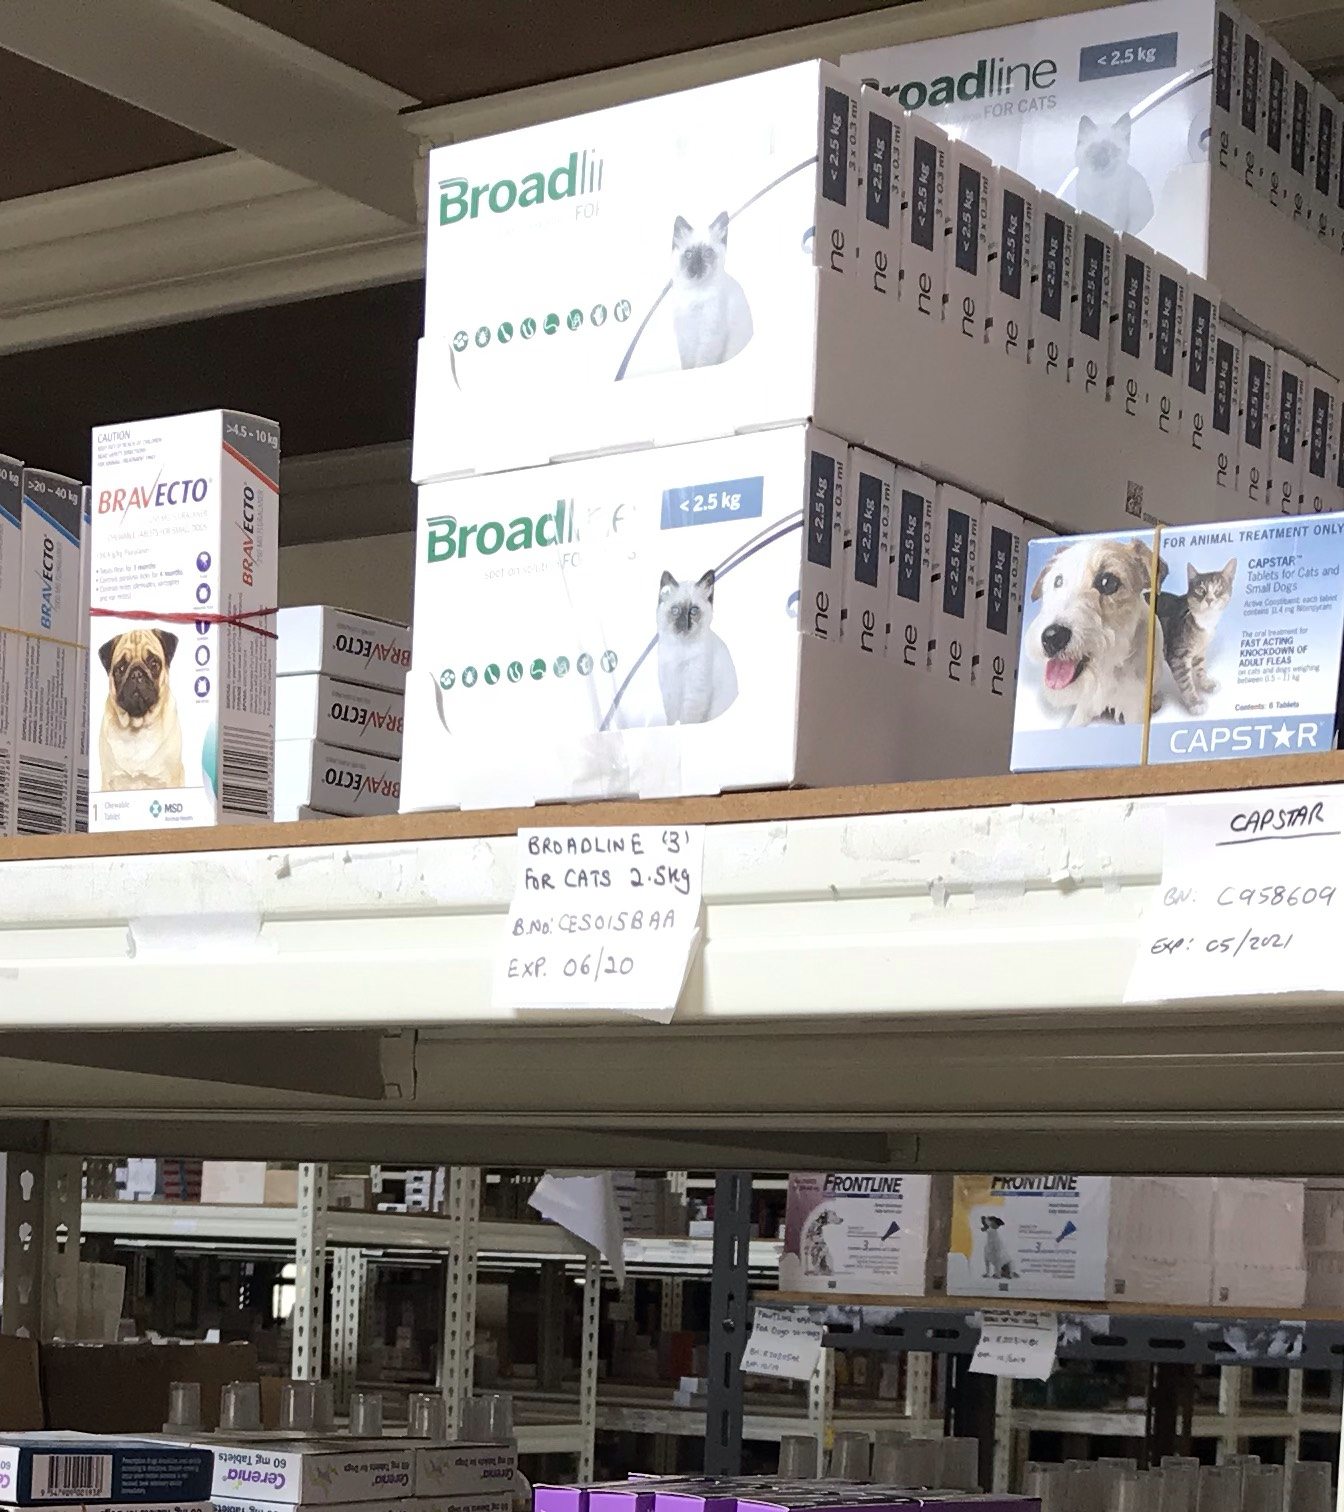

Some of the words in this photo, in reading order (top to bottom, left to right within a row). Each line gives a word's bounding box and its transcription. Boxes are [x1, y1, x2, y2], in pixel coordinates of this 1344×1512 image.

[1111, 47, 1132, 65] 2.5
[1135, 46, 1156, 64] kg
[984, 102, 1014, 118] FOR
[1018, 94, 1057, 114] CATS
[98, 476, 208, 516] BRAVECTO
[693, 494, 717, 513] 2.5
[722, 491, 741, 512] kg
[243, 485, 255, 587] BRAVECTO
[1164, 535, 1186, 548] FOR
[1190, 531, 1235, 547] ANIMAL
[1239, 525, 1309, 543] TREATMENT
[1313, 522, 1344, 536] ONLY
[1247, 570, 1279, 582] Tablets
[1282, 569, 1295, 580] for
[1298, 567, 1319, 578] Cats
[1322, 564, 1340, 576] and
[1246, 583, 1271, 595] Small
[1273, 581, 1298, 594] Dogs
[1241, 638, 1261, 648] FAST
[1263, 636, 1294, 647] ACTING
[1230, 802, 1324, 833] CAPSTAR
[528, 833, 645, 856] BROADLINE
[564, 868, 612, 888] CATS
[563, 945, 634, 982] 06/20
